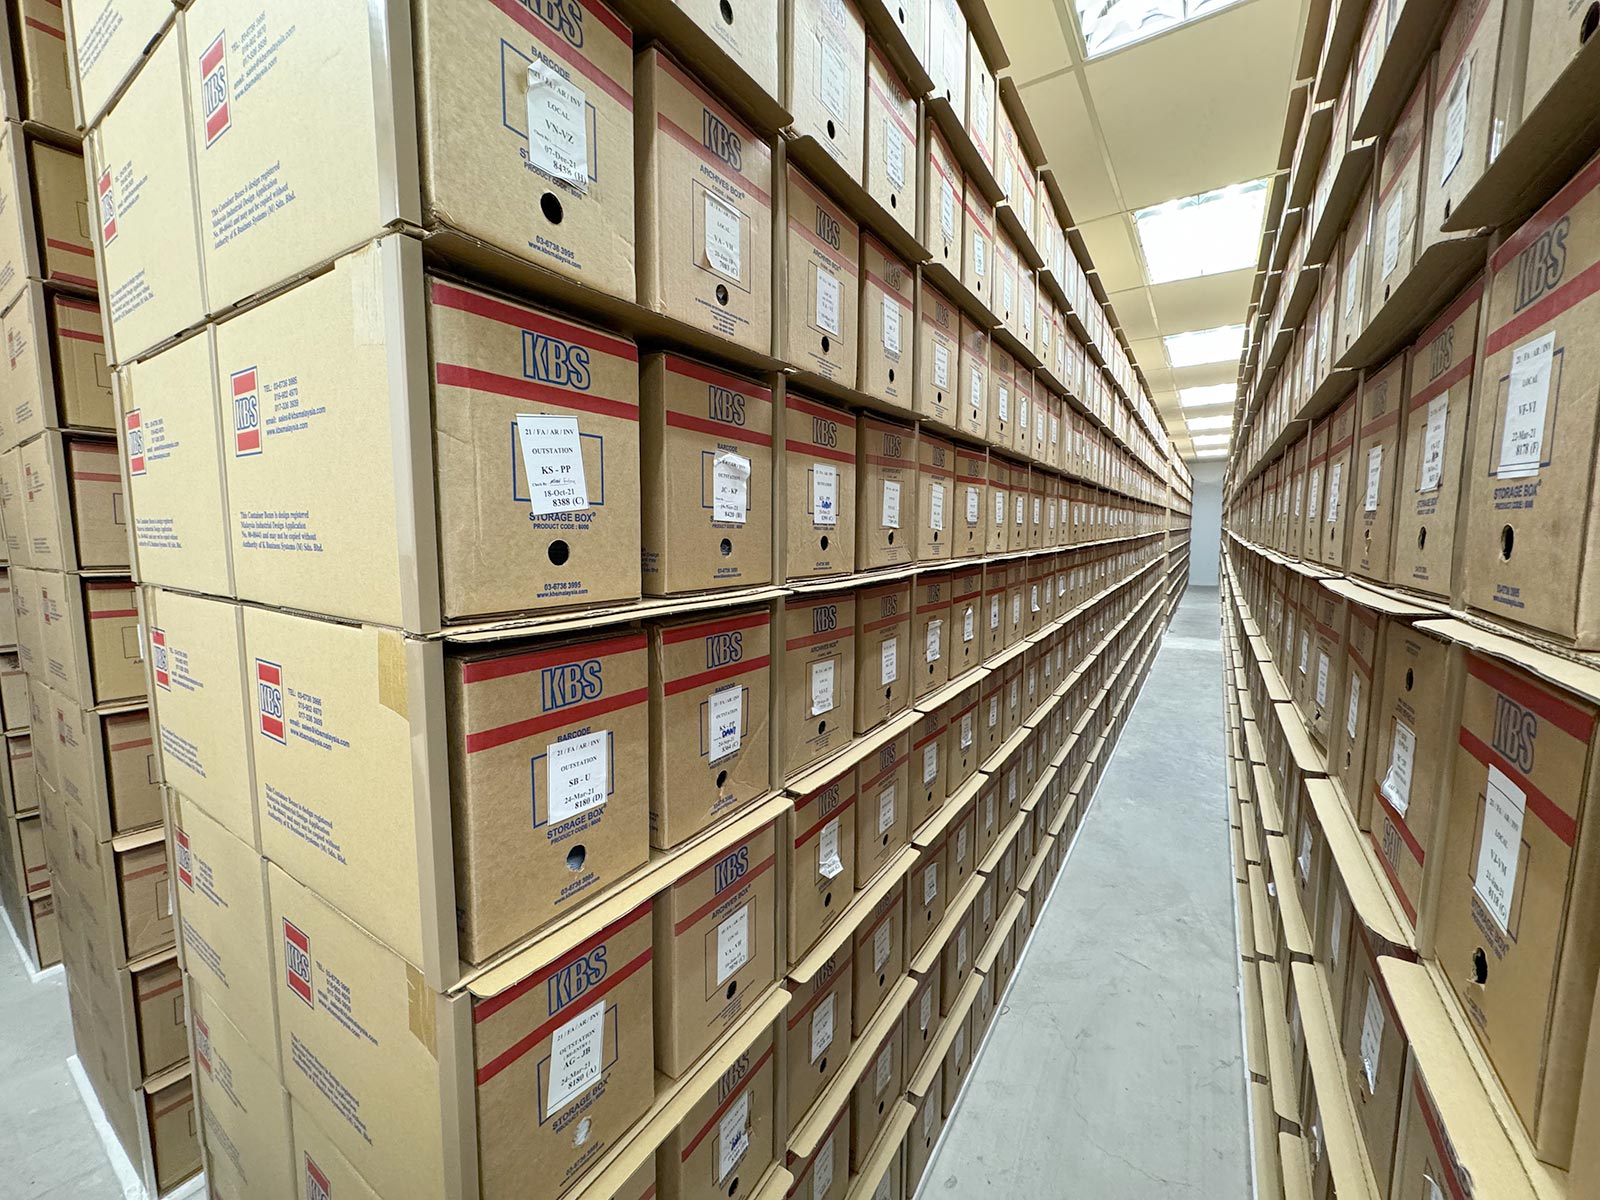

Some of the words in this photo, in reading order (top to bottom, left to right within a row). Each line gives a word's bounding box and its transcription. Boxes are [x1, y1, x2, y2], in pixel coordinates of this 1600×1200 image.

[204, 65, 226, 118] KBS
[547, 100, 570, 121] LOCAL
[703, 108, 742, 173] KBS
[700, 164, 729, 190] ARCHIVES
[816, 205, 841, 251] KBS
[884, 258, 901, 291] KBS
[1514, 215, 1571, 314] KBS
[522, 329, 591, 391] KBS
[1430, 324, 1454, 381] KBS
[235, 394, 258, 431] KBS
[708, 385, 745, 426] KBS
[536, 428, 546, 436] FA
[813, 416, 837, 448] KBS
[531, 447, 574, 455] OUTSTATION
[717, 443, 738, 452] BARCODE
[884, 433, 902, 458] KBS
[541, 465, 554, 475] KS
[560, 464, 571, 473] PP
[544, 488, 575, 498] 18-Oct-21
[552, 498, 571, 507] 8388
[572, 497, 585, 507] (C)
[1494, 485, 1523, 500] STORAGE
[529, 512, 573, 522] STORAGE
[536, 588, 589, 598] www.kbsmalaysia.com
[568, 581, 582, 589] 3995
[813, 605, 837, 634] KBS
[880, 595, 898, 619] KBS
[706, 631, 743, 669] KBS
[541, 659, 603, 712] KBS
[259, 683, 282, 719] KBS
[557, 726, 592, 743] BARCODE
[567, 746, 575, 754] FA
[578, 743, 588, 751] AR
[590, 738, 601, 747] INV
[1492, 693, 1537, 774] KBS
[560, 755, 598, 772] OUTSTATION
[880, 743, 897, 773] KBS
[569, 777, 579, 787] SB
[585, 773, 591, 781] U
[564, 787, 595, 804] 24-Mar-21
[592, 793, 603, 803] (D)
[819, 784, 840, 820] KBS
[547, 815, 586, 840] STORAGE
[551, 830, 574, 845] PRODUCT
[714, 846, 748, 895] KBS
[287, 941, 310, 983] KBS
[548, 945, 607, 1016] KBS
[559, 1029, 596, 1056] OUTSTATION
[563, 1057, 576, 1070] AG
[552, 1092, 591, 1130] STORAGE
